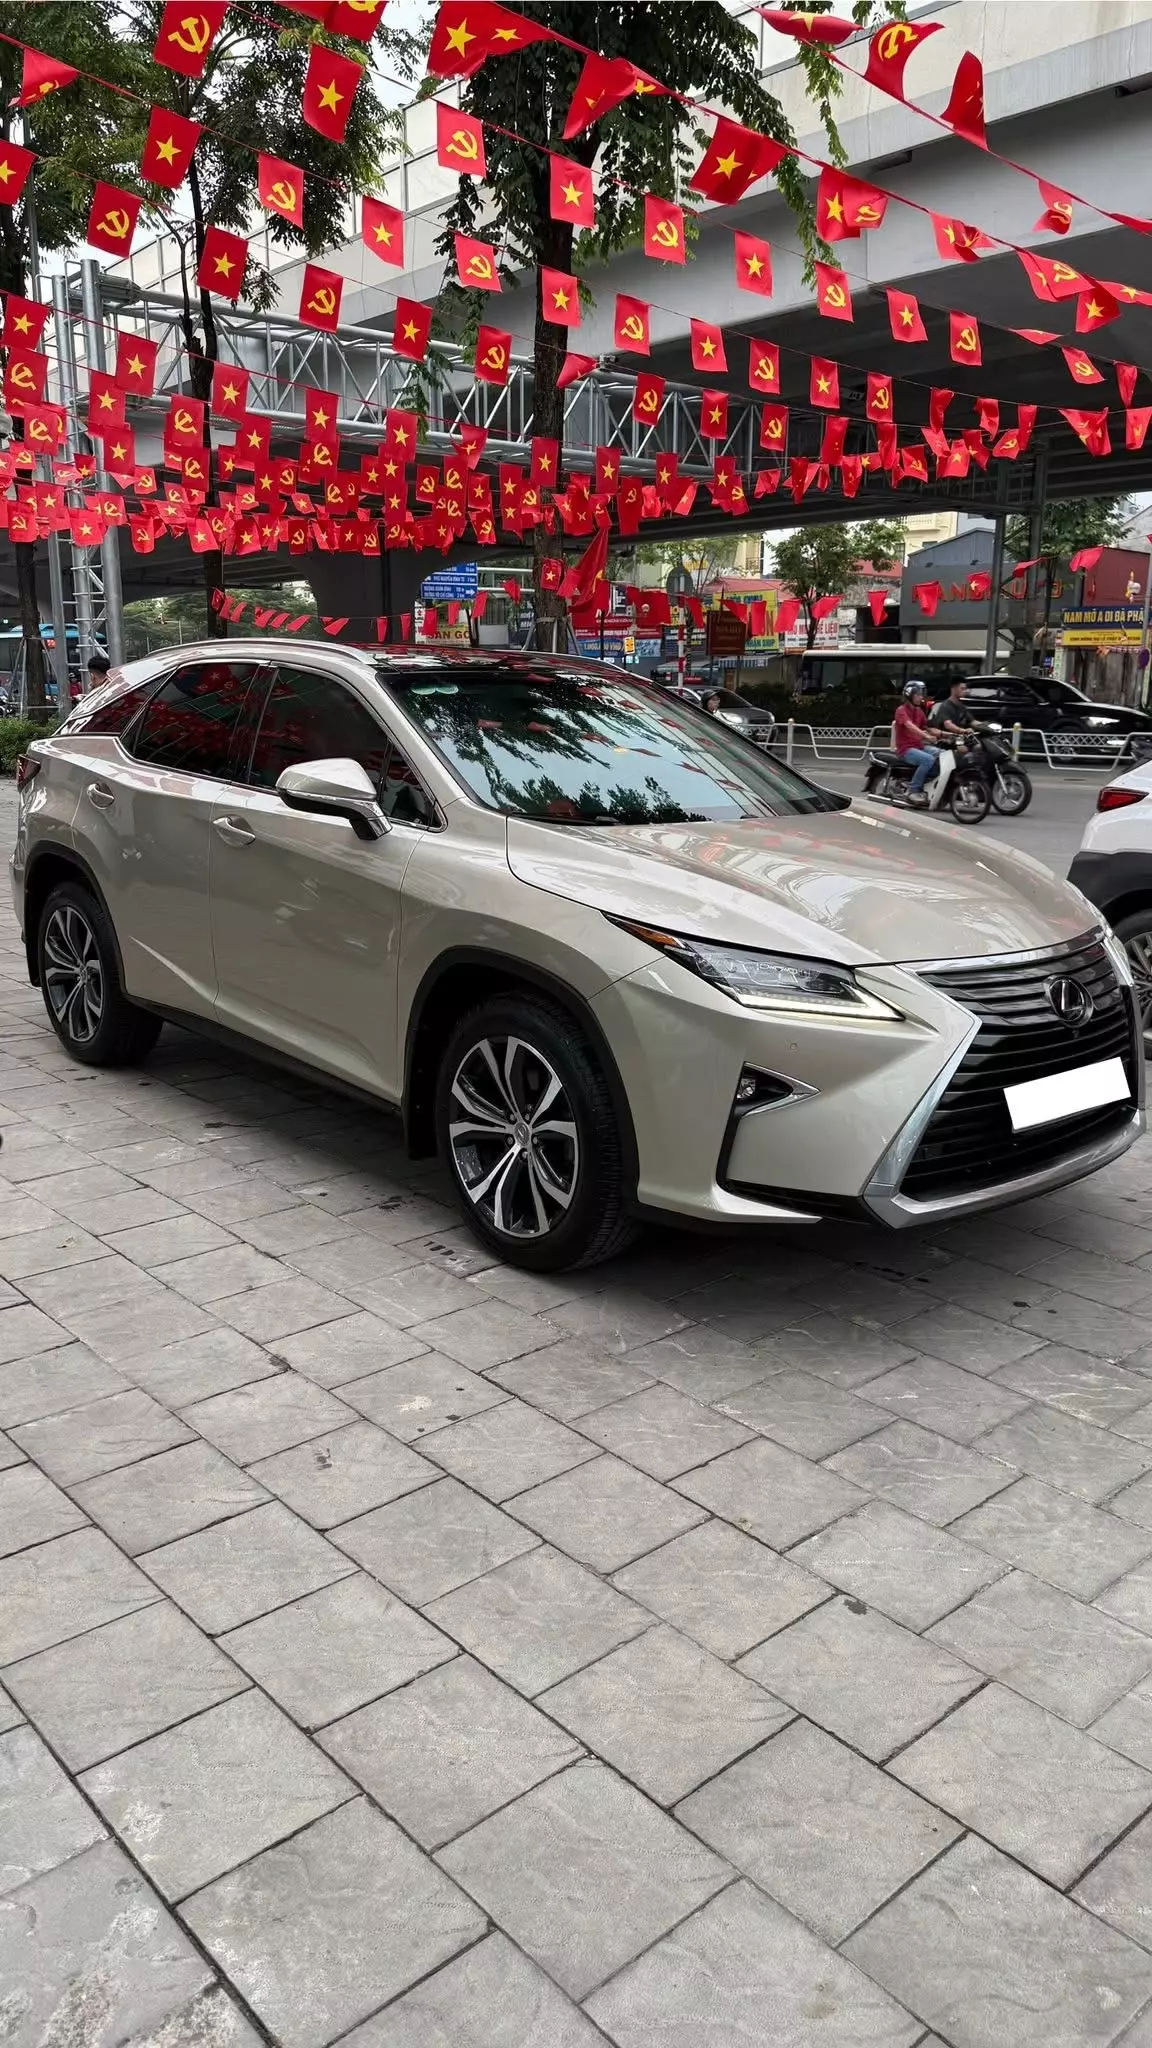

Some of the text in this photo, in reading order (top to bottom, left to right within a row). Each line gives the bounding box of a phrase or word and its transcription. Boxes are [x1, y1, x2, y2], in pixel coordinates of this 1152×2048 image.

[1063, 611, 1083, 624] NAM
[1097, 611, 1103, 622] A
[1104, 610, 1113, 622] DI
